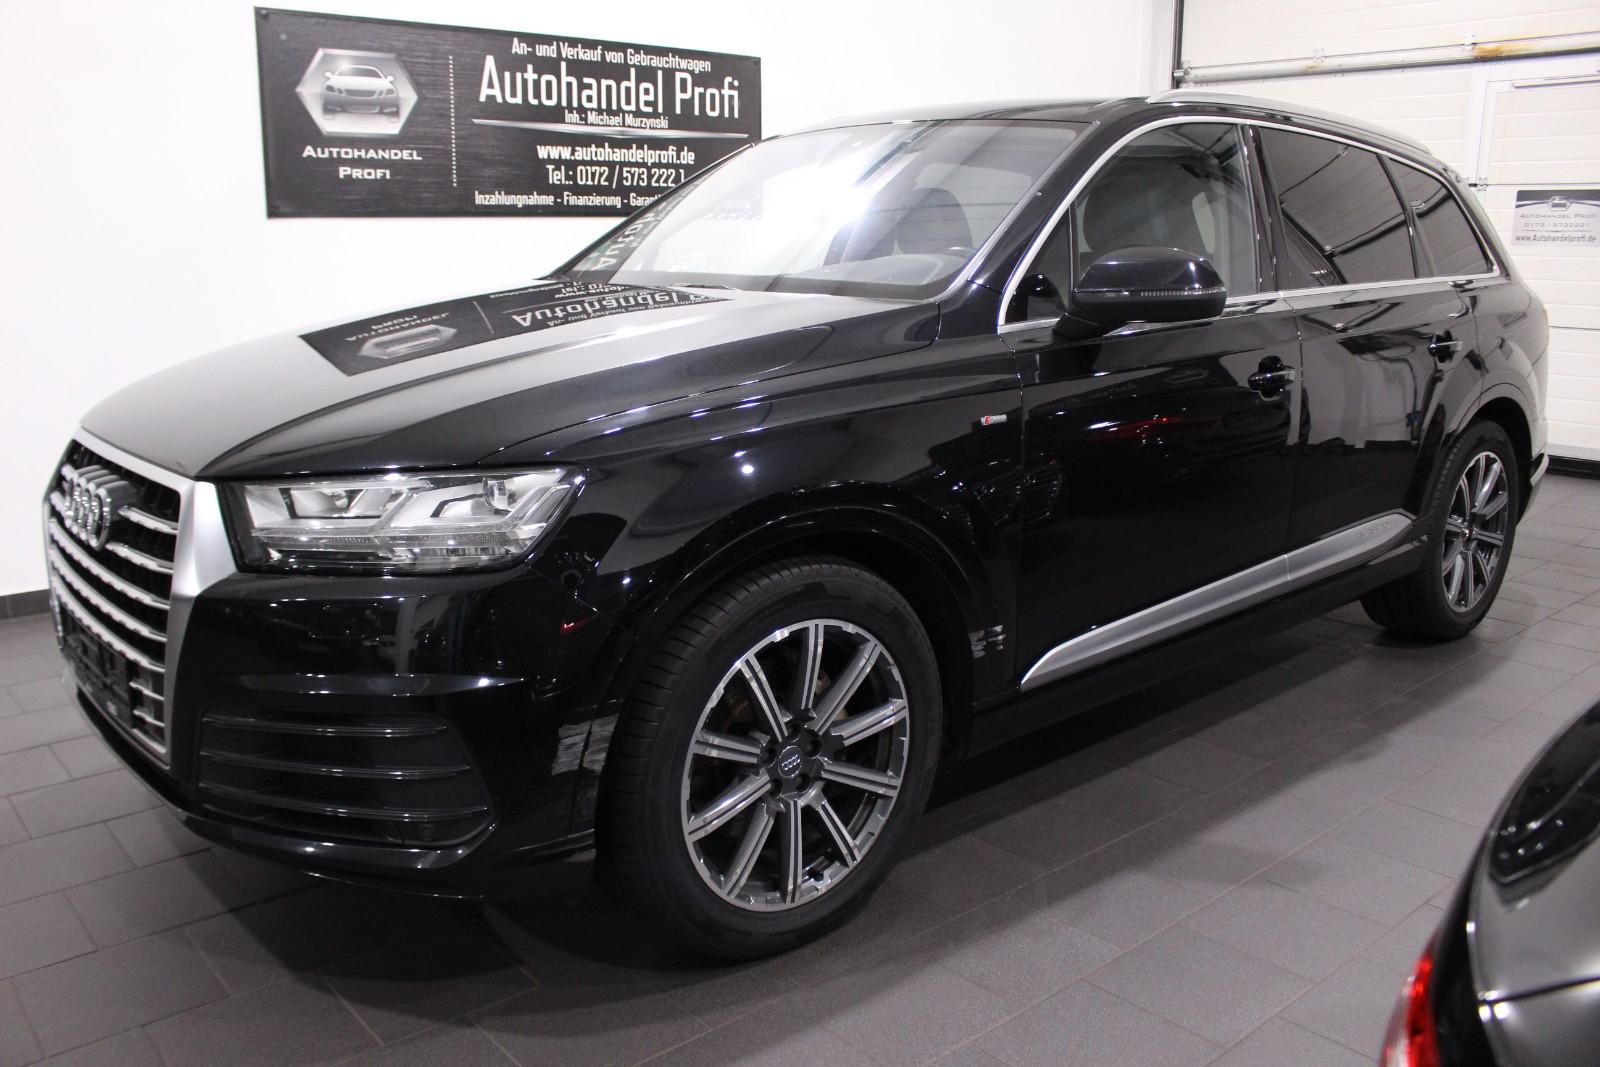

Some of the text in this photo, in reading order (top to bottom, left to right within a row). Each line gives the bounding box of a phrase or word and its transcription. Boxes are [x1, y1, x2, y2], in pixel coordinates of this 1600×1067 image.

[511, 37, 711, 74] An- und Verkauf von Gebrauchtwagen
[479, 54, 739, 119] Autohandel Profi
[564, 109, 669, 130] Inh.: Michael Murzynski
[302, 145, 423, 179] AUTOHANDEL PROFI
[537, 142, 695, 166] www.autohandelprofi.de
[546, 165, 573, 185] Tel.:
[576, 165, 609, 186] 0172
[612, 165, 620, 189] /
[622, 167, 648, 187] 573
[651, 168, 676, 187] 222
[474, 191, 555, 208] Inzahlungnahme
[563, 191, 621, 209] Finanzierung
